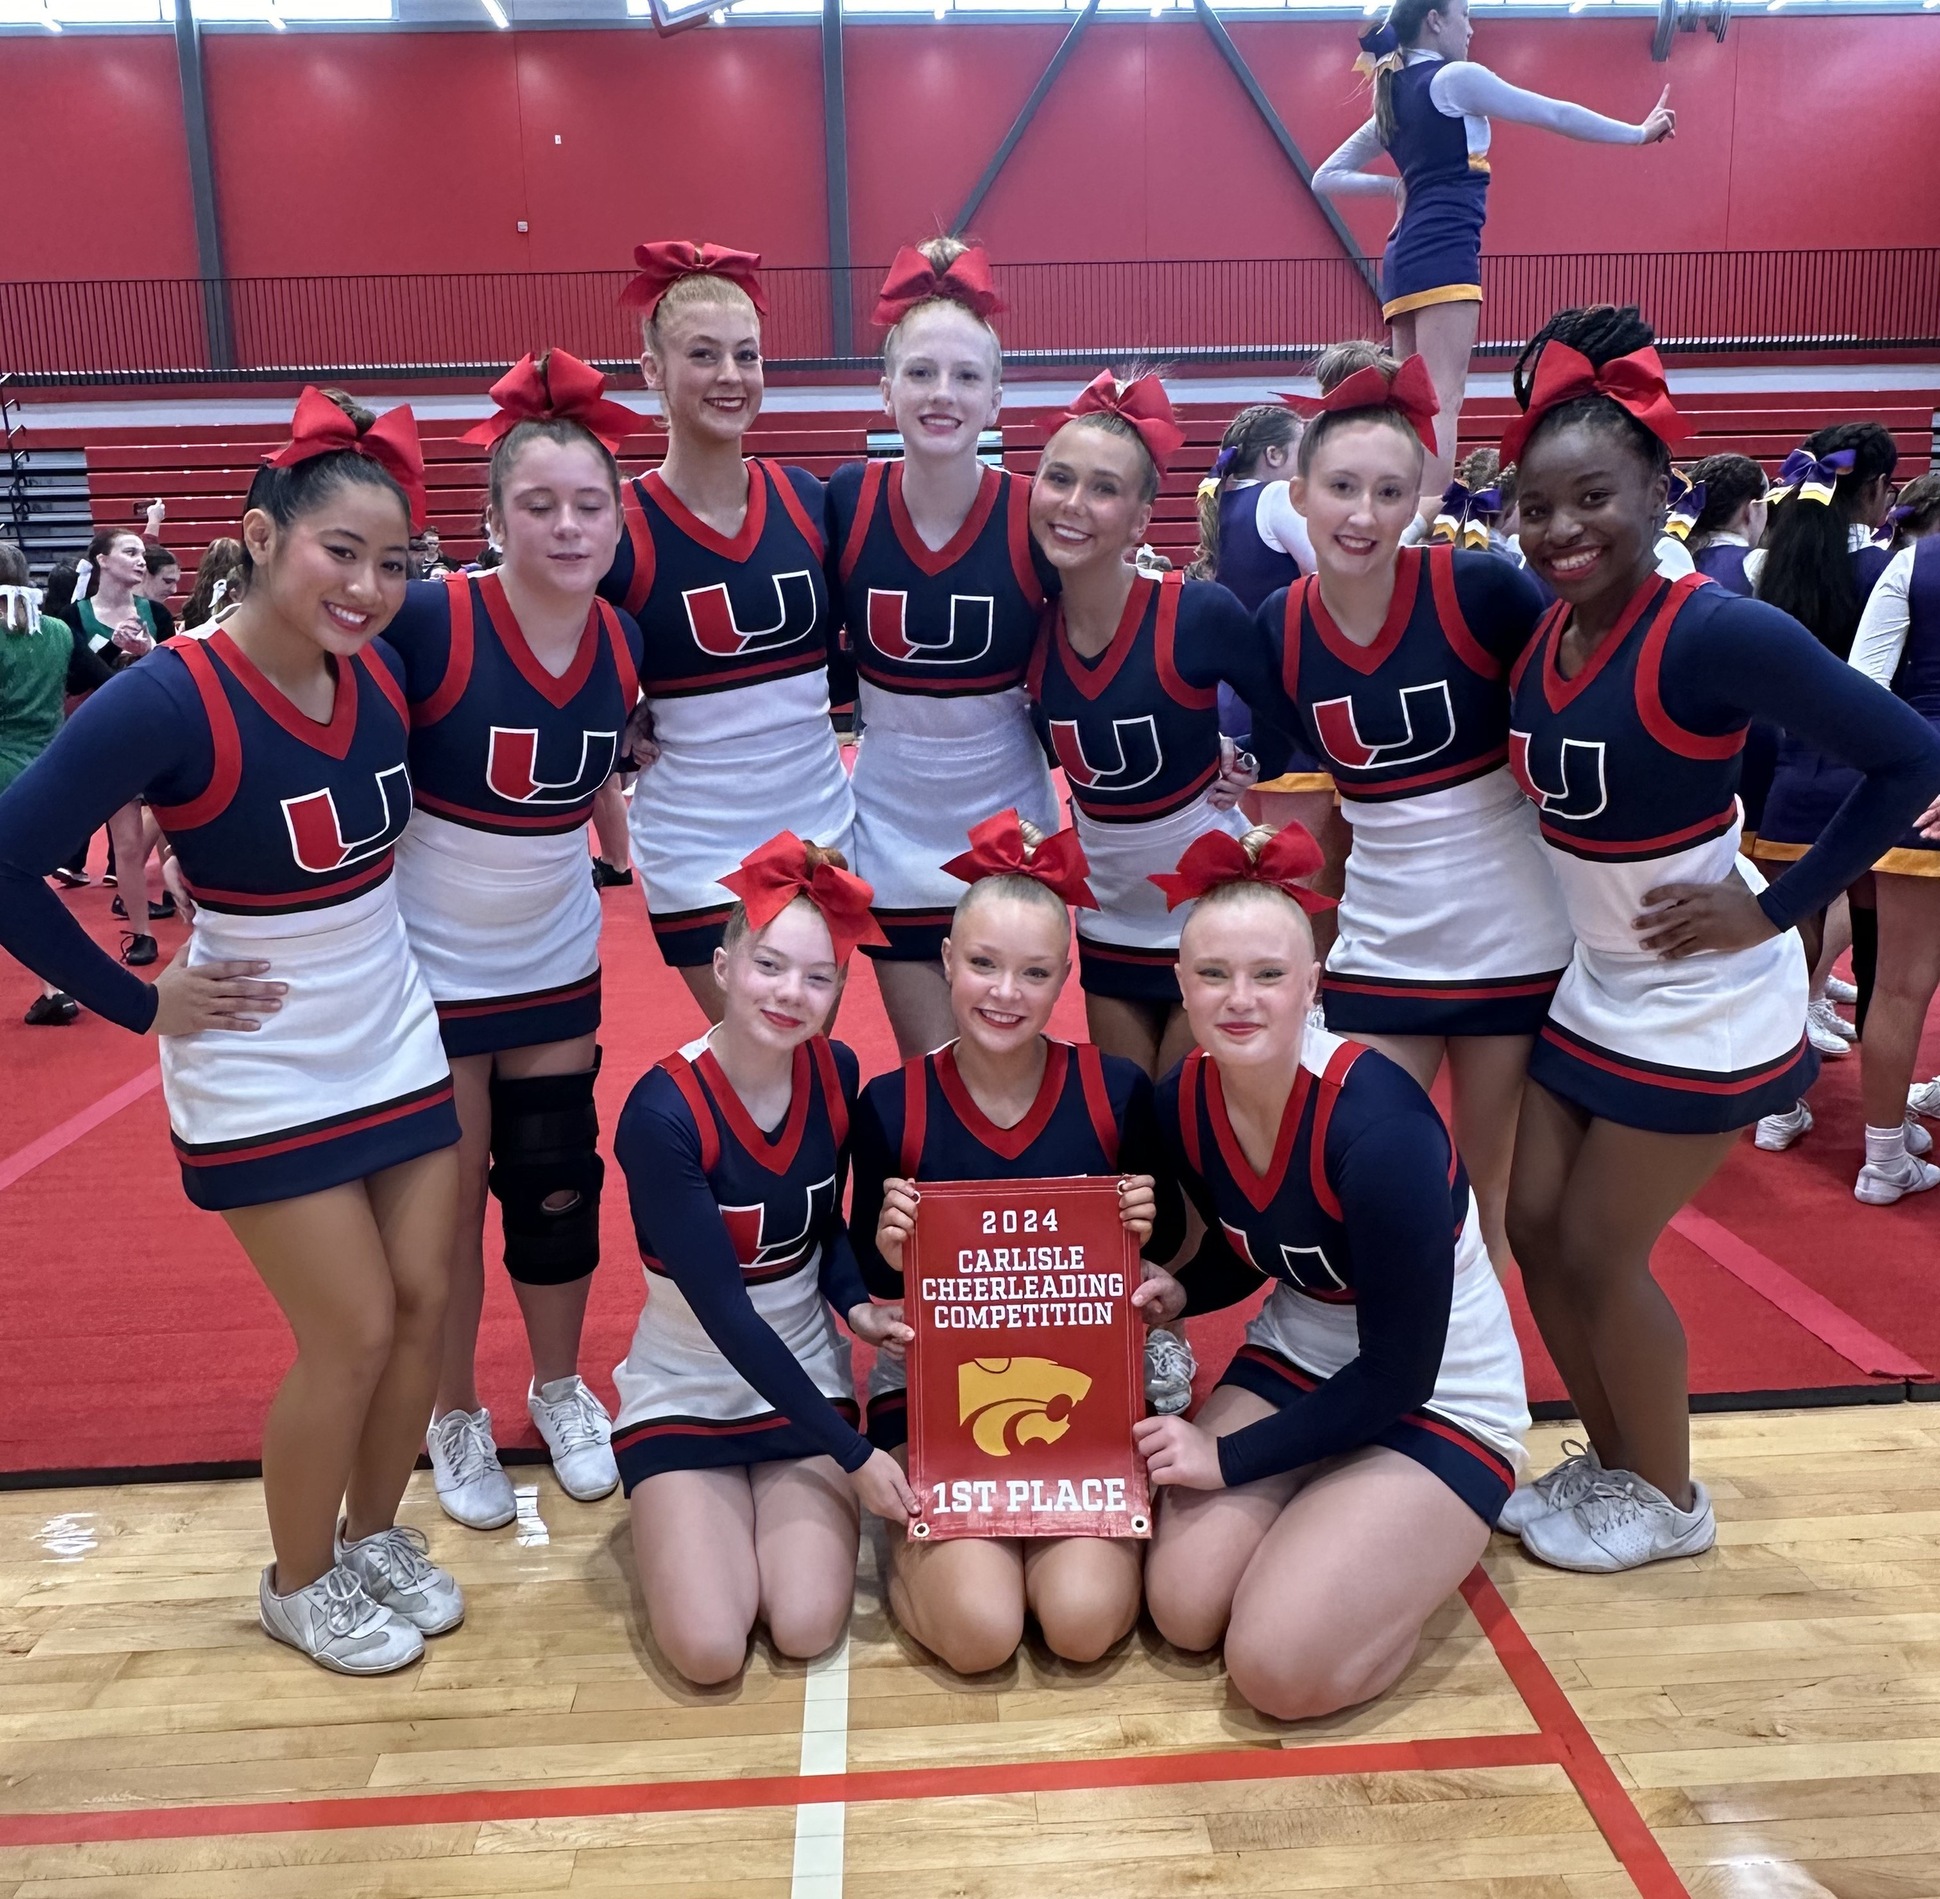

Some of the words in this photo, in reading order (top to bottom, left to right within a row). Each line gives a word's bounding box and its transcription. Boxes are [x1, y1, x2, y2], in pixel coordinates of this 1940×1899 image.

[681, 569, 817, 657] U
[867, 588, 994, 665] U
[1049, 714, 1163, 791] U
[1312, 679, 1456, 770] U
[486, 725, 618, 804] U
[1509, 728, 1608, 820] U
[280, 761, 414, 873] U
[958, 1245, 1085, 1274] CARLISLE
[982, 1208, 1058, 1234] 2024
[922, 1273, 1124, 1301] CHEERLEADING
[934, 1301, 1114, 1329] COMPETITION
[932, 1480, 997, 1515] 1ST
[1005, 1477, 1128, 1513] PLACE
